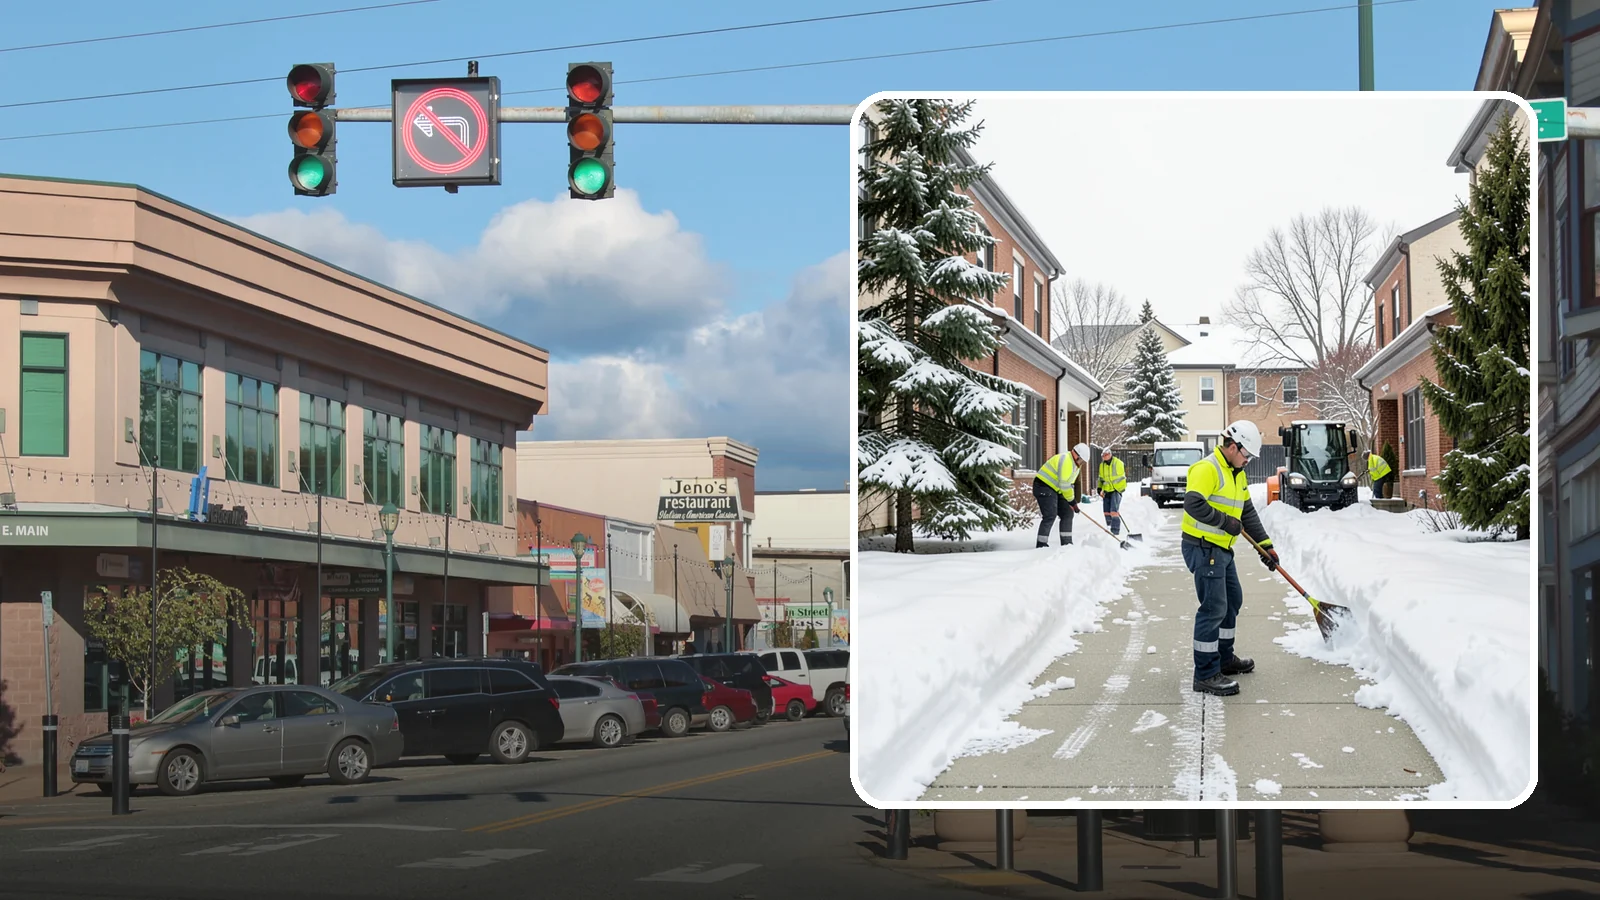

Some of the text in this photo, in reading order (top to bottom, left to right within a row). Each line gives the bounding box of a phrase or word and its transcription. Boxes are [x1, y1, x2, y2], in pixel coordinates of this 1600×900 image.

[670, 480, 727, 494] Jeno's
[665, 497, 730, 509] restaurant
[659, 510, 681, 519] Italian
[686, 510, 715, 519] American
[715, 510, 737, 519] Cuisine
[2, 525, 49, 536] E. MAIN
[798, 608, 828, 616] Street
